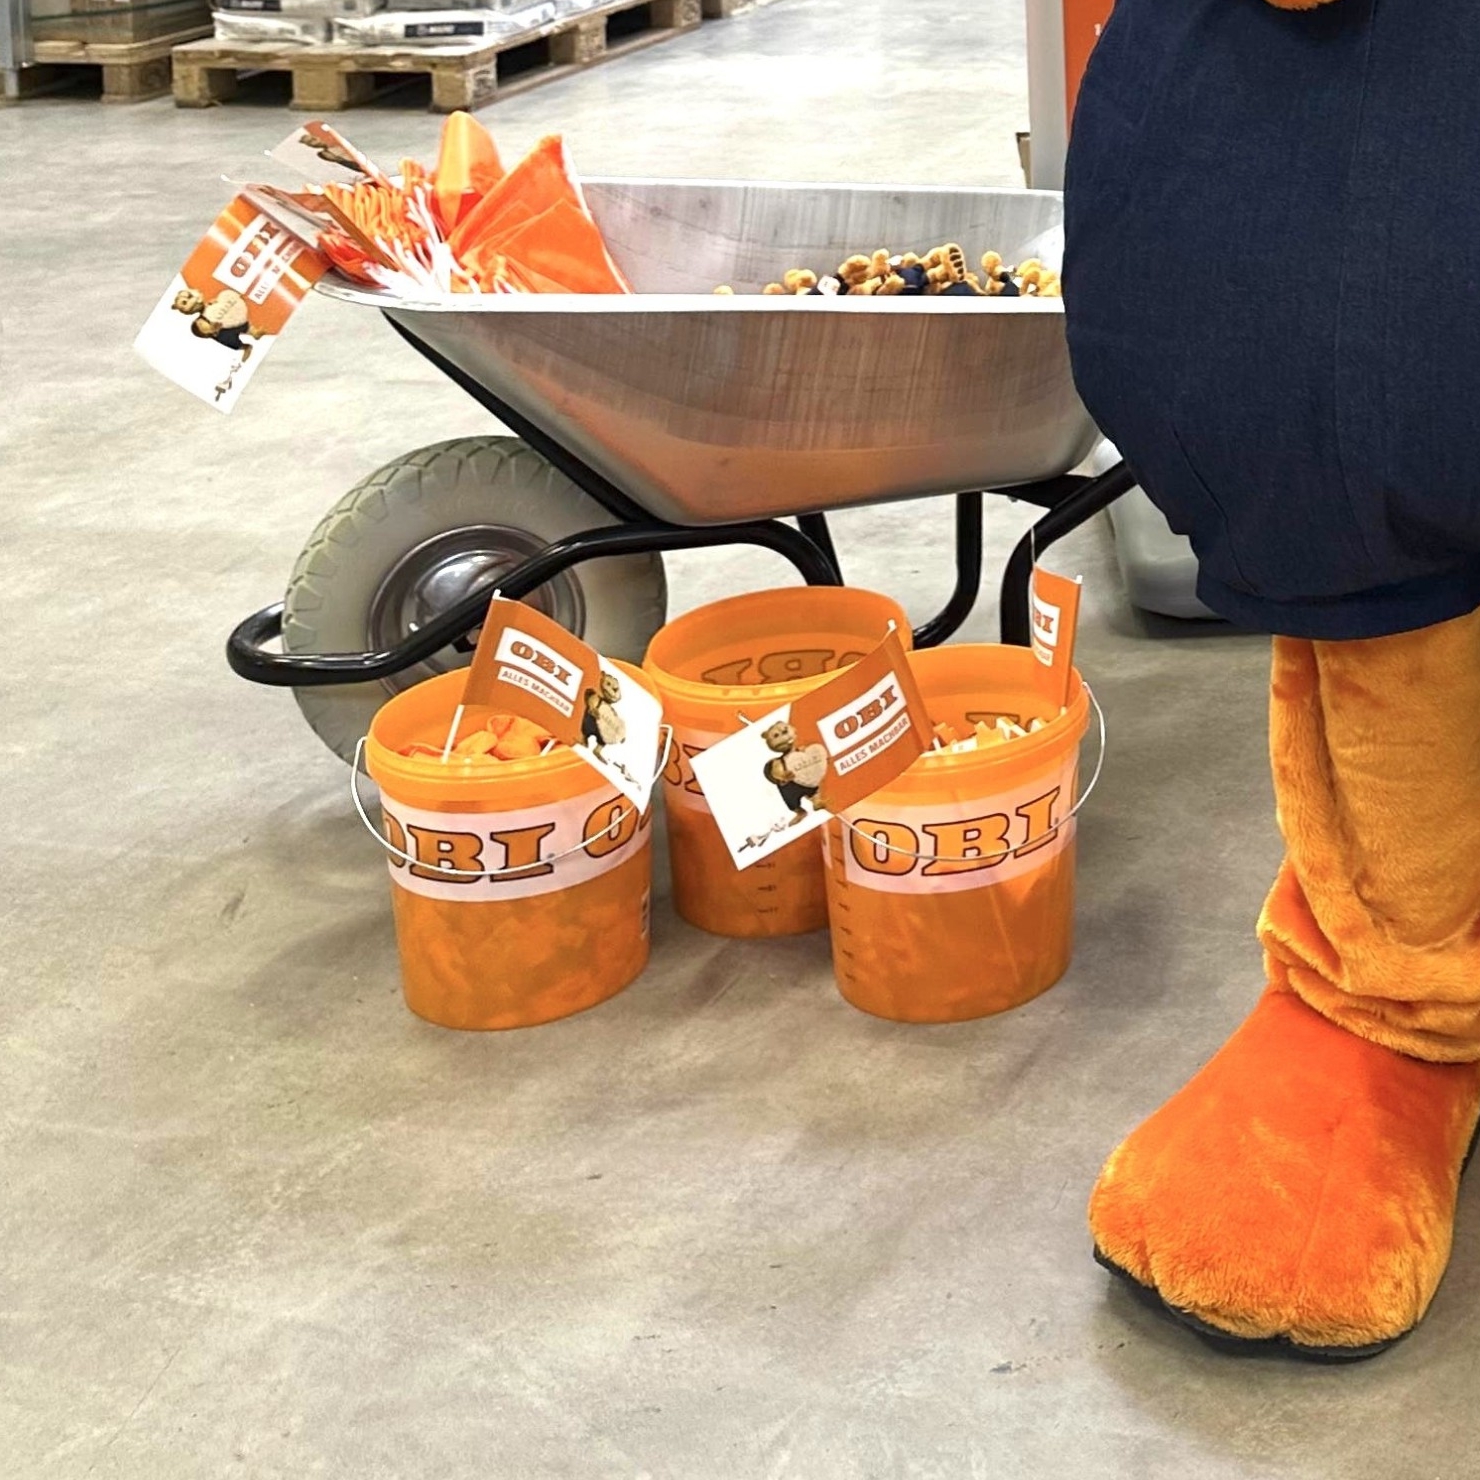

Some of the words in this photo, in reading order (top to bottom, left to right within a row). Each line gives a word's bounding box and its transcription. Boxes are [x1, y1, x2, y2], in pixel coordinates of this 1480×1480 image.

[501, 670, 531, 687] ALLES
[510, 640, 573, 687] OBI
[833, 685, 899, 740] OBI
[839, 748, 868, 771] ALLES
[868, 717, 909, 754] MACHBAR
[849, 786, 1061, 877] OBI
